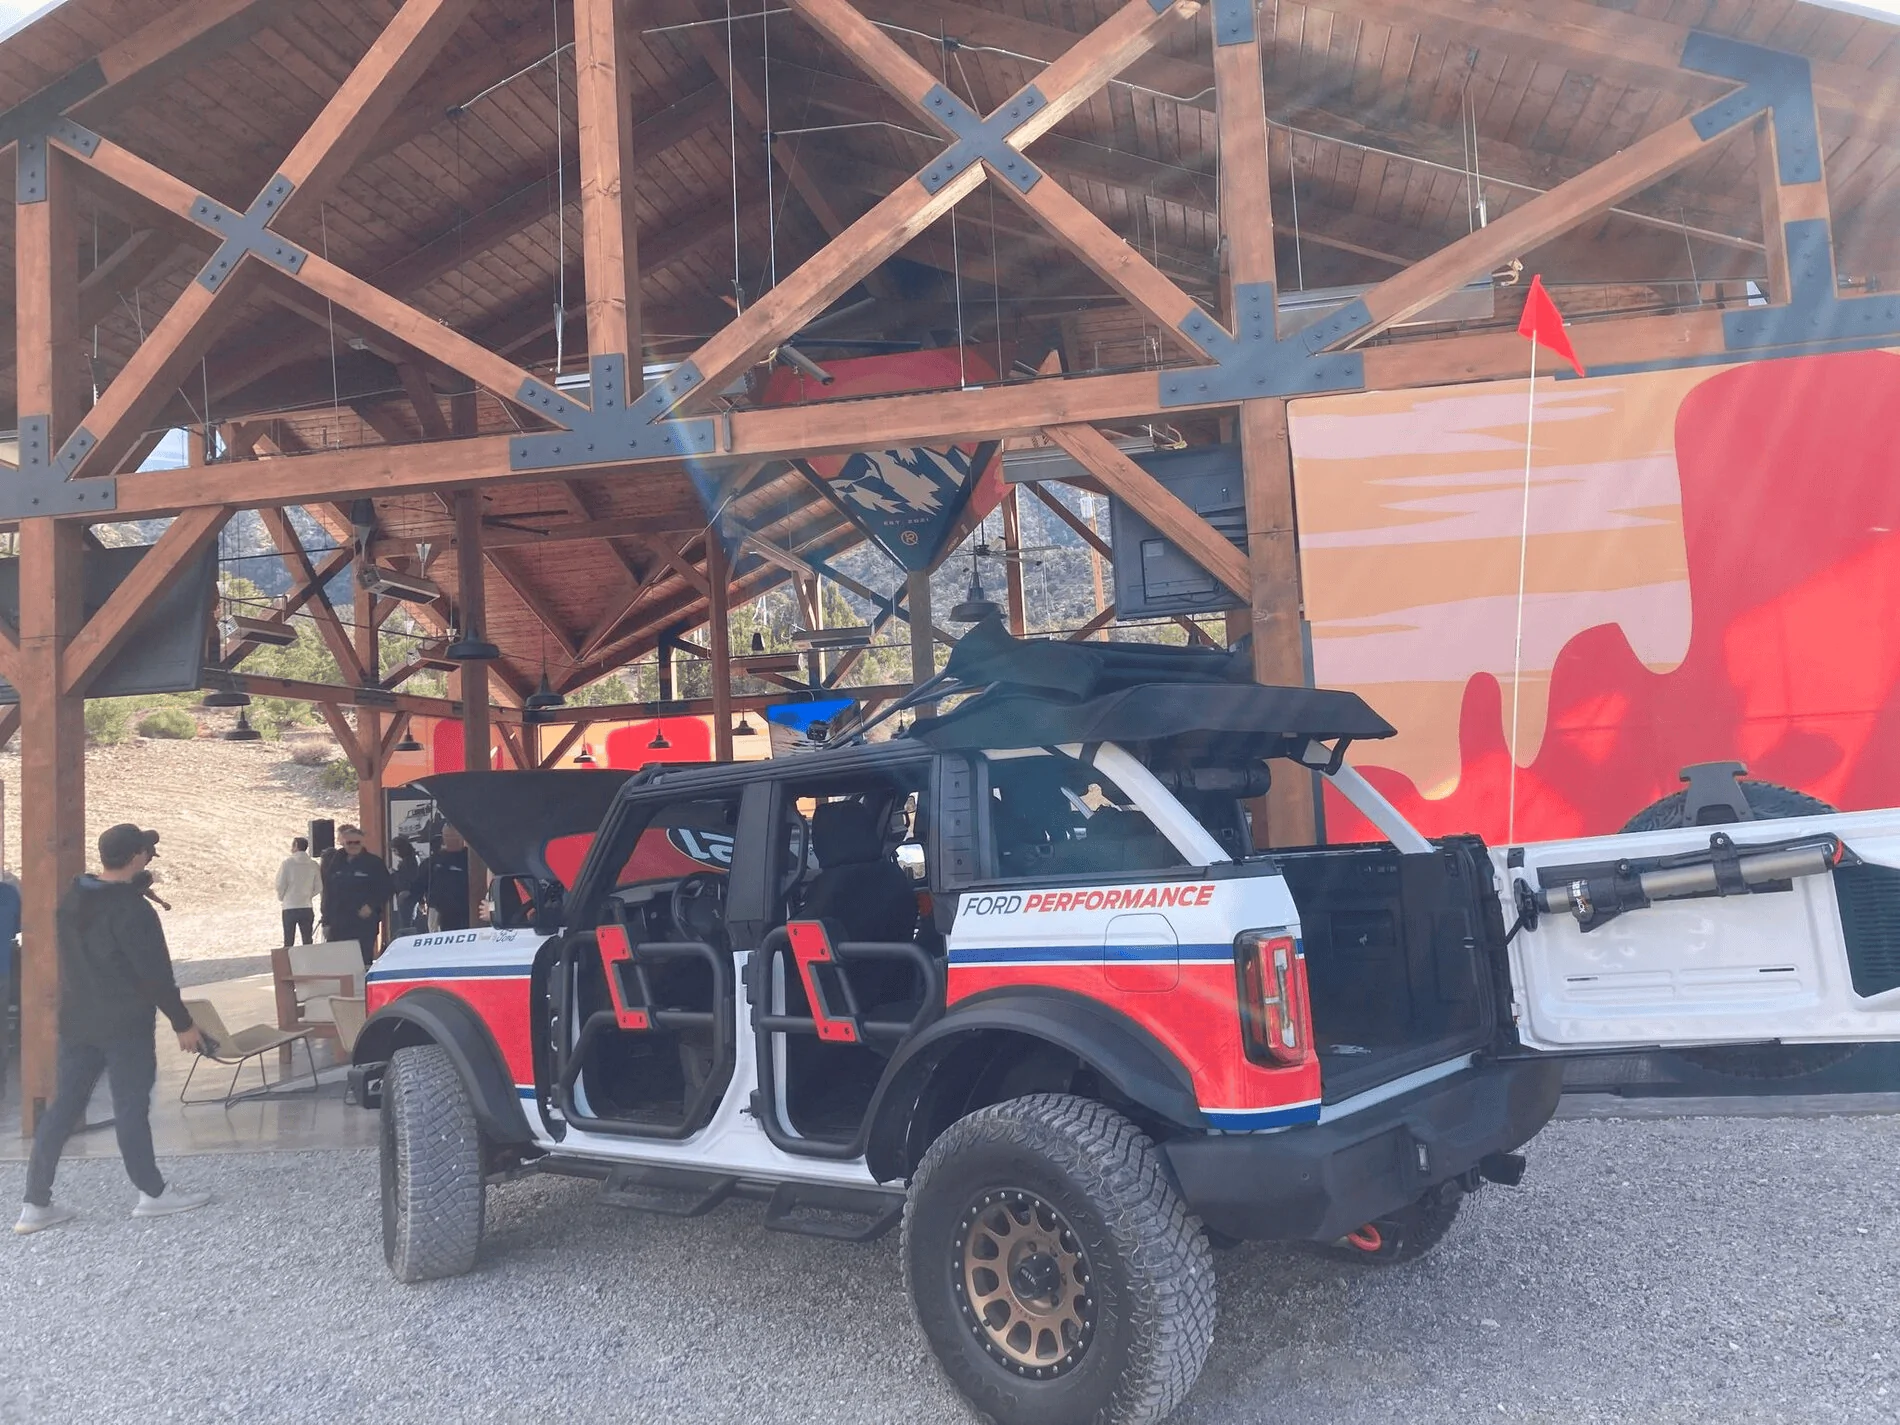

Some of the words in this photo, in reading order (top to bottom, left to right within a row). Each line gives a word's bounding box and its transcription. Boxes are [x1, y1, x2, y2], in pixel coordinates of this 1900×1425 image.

[963, 896, 1022, 916] FORD
[1022, 885, 1215, 913] PERFORMANCE
[413, 933, 477, 947] BRONCO
